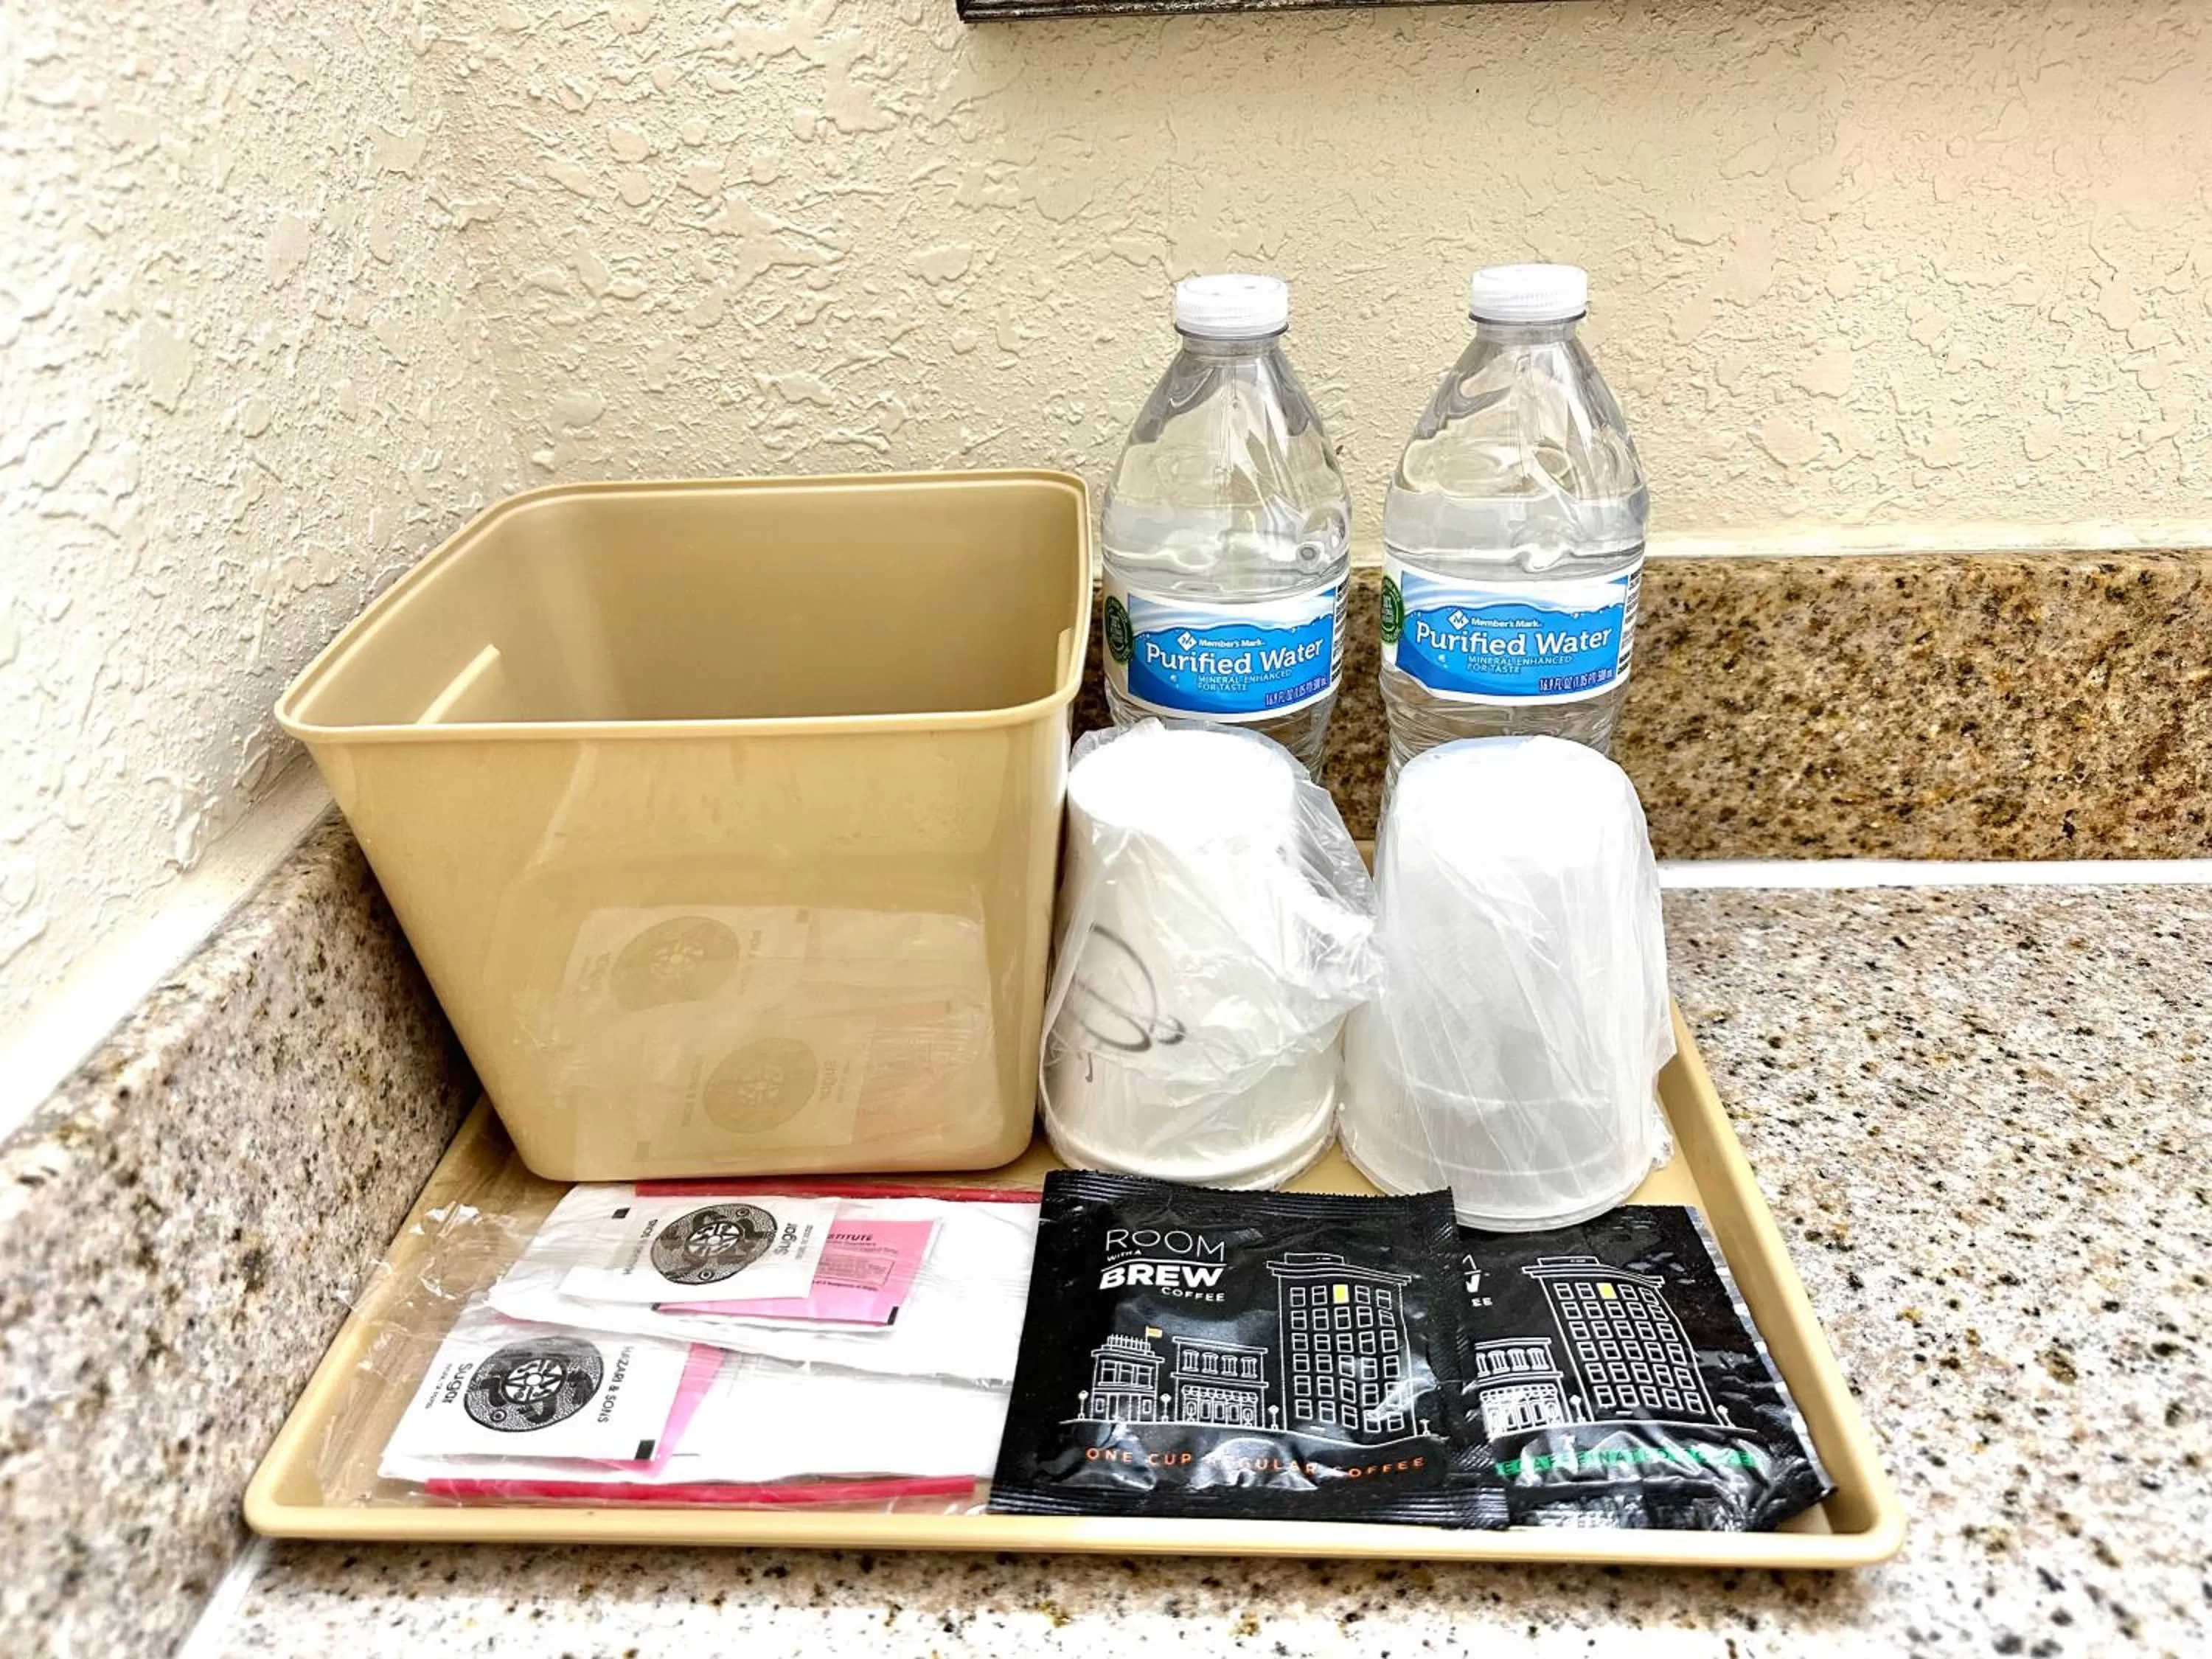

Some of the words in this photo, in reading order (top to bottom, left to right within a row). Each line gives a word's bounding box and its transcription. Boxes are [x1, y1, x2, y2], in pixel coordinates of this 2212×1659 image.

[1471, 617, 1514, 627] Member's
[1198, 638, 1239, 648] Member's
[1416, 620, 1526, 655] Purified
[1535, 628, 1613, 655] Water
[1146, 640, 1252, 675] Purified
[1260, 637, 1324, 672] Water
[1467, 655, 1512, 664] MINERAL
[1517, 656, 1573, 665] ENHANCED
[1198, 675, 1240, 684] MINERAL
[1244, 669, 1293, 684] ENHANCED
[1490, 665, 1520, 673] TASTE
[1197, 683, 1217, 691] FOR
[773, 1222, 798, 1256] Sugar
[1105, 1228, 1225, 1263] ROOM
[1107, 1250, 1133, 1262] WITH
[1099, 1263, 1225, 1290] BREW
[1161, 1286, 1225, 1302] COFFEE
[442, 1361, 474, 1404] Sugar
[597, 1393, 617, 1424] SONS
[1085, 1447, 1133, 1464] ONE
[1147, 1453, 1193, 1466] CUP
[1205, 1455, 1317, 1475] GULAR
